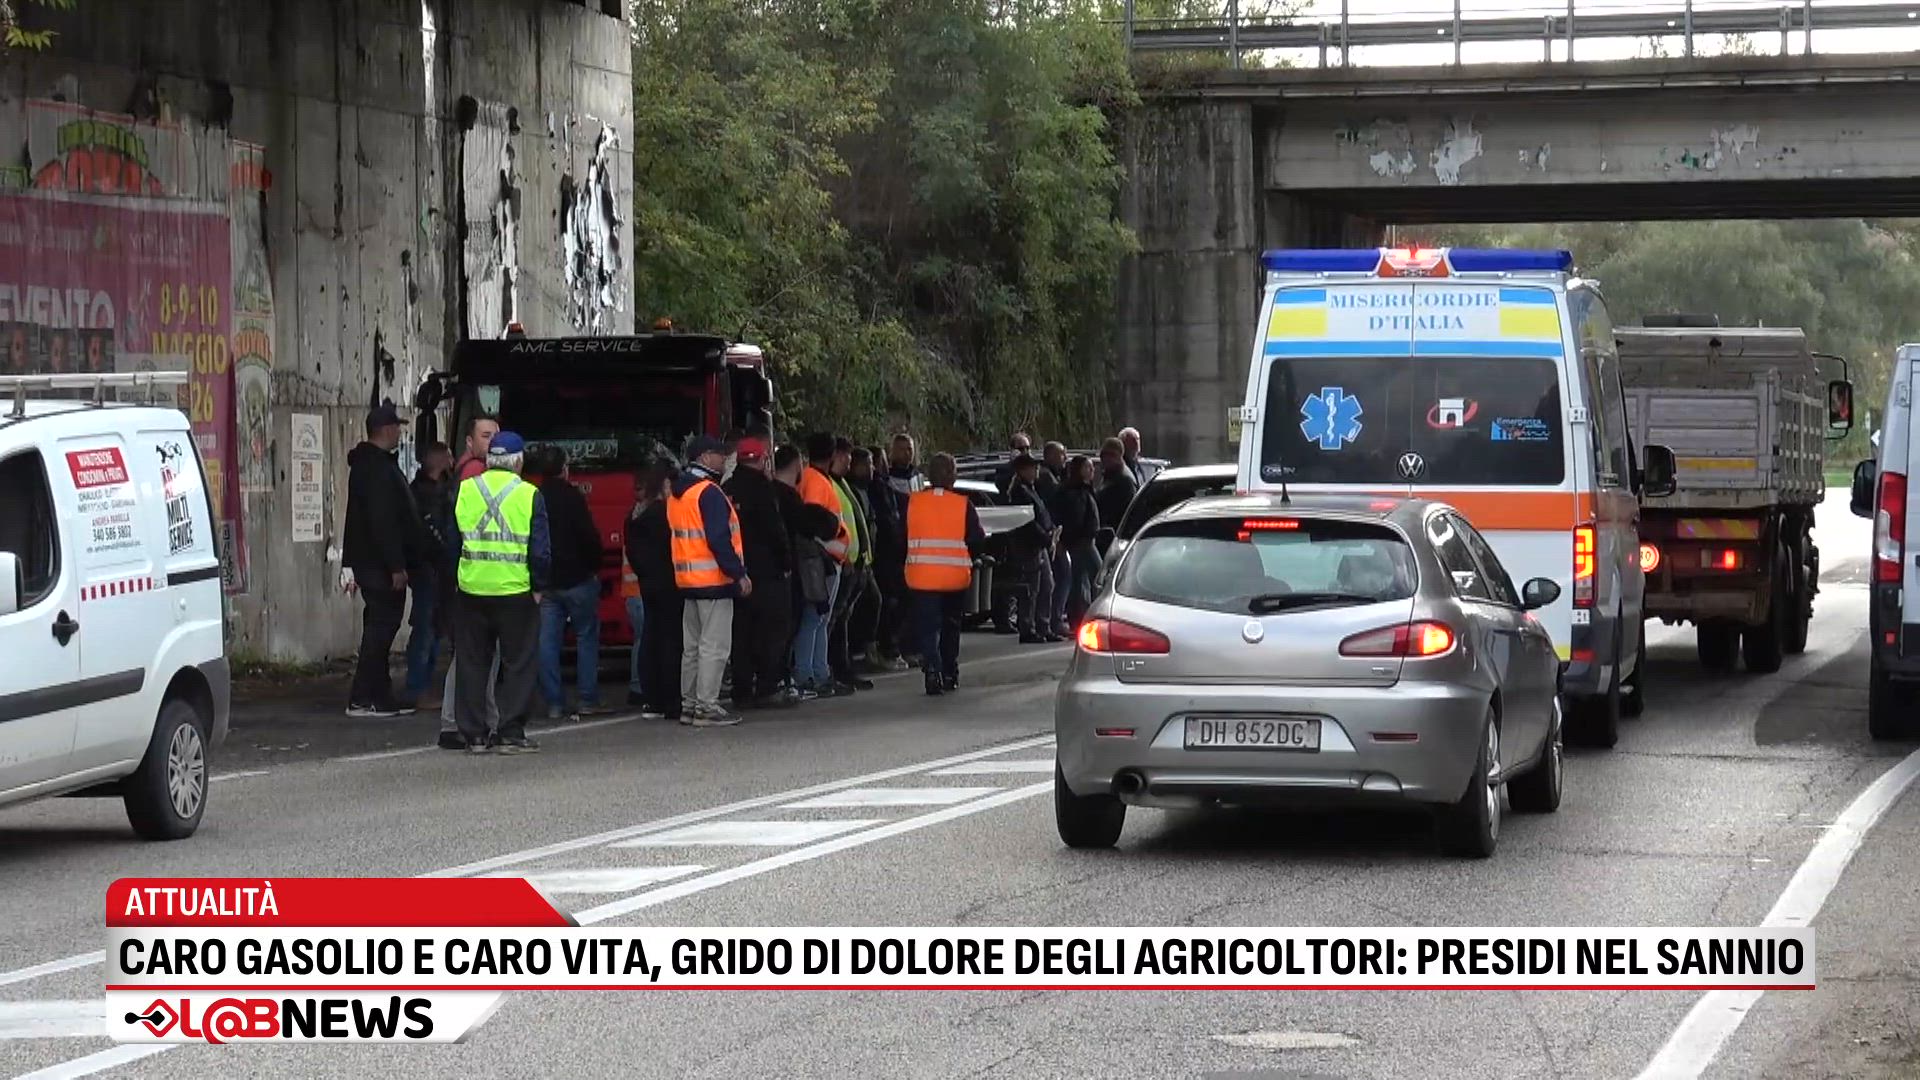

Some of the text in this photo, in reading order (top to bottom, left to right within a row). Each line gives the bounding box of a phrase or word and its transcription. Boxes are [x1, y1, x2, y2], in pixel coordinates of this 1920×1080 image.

[160, 283, 218, 326] 8-9-10
[1331, 293, 1497, 308] MISERICORDIE
[1369, 315, 1464, 330] D'ITALIA
[510, 340, 642, 353] AMC SERVICE
[169, 520, 193, 555] SERVICE
[1201, 721, 1304, 745] DH 852DG
